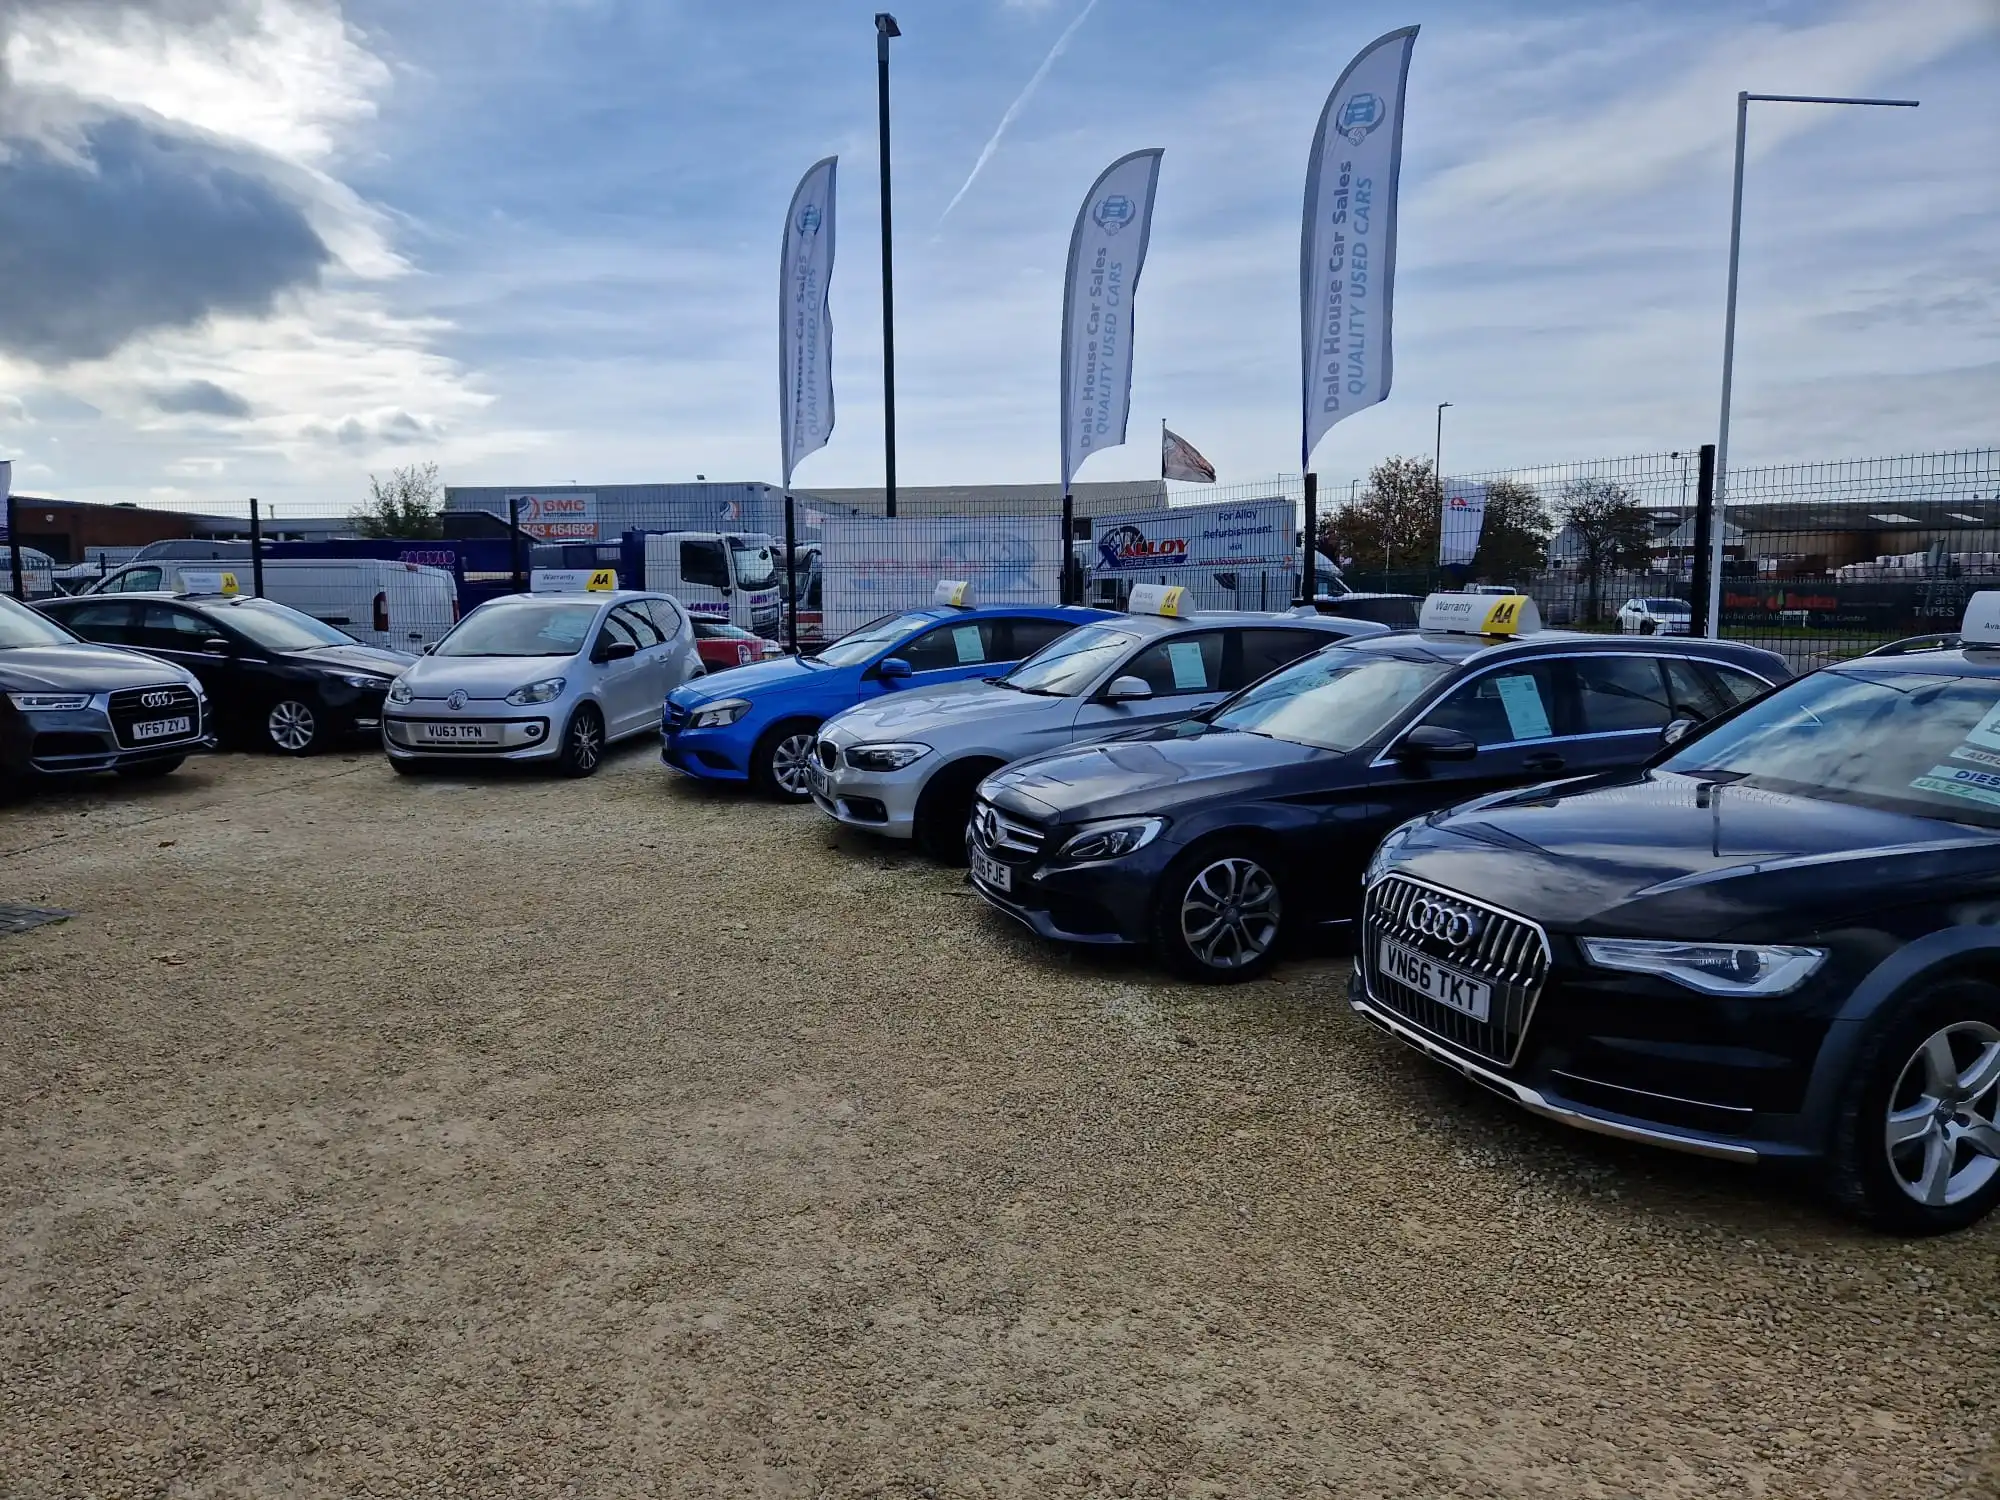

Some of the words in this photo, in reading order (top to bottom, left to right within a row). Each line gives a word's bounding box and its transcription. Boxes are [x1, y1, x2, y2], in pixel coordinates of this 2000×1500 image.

[1332, 160, 1352, 225] Sales
[1353, 177, 1373, 236] CARS
[1090, 247, 1107, 296] Sales
[1329, 231, 1346, 273] Car
[1350, 242, 1369, 299] USED
[1107, 261, 1122, 307] CARS
[1087, 302, 1100, 336] Car
[1102, 312, 1118, 357] USED
[1324, 280, 1343, 356] House
[1083, 341, 1098, 401] House
[1347, 305, 1366, 395] QUALITY
[807, 364, 820, 436] QUALITY
[1096, 364, 1114, 435] QUALITY
[1324, 362, 1340, 413] Dale
[1080, 408, 1093, 449] Dale
[543, 499, 586, 512] GMC
[1218, 512, 1234, 521] For
[1235, 509, 1258, 520] Alloy
[549, 523, 594, 536] 464692
[1119, 539, 1190, 557] ALLOY
[1203, 525, 1273, 540] Refurbishment
[543, 573, 576, 581] Warranty
[592, 574, 609, 585] AA
[1435, 600, 1473, 614] Warranty
[1490, 602, 1516, 624] AA
[138, 722, 166, 737] YF67
[167, 718, 187, 732] ZYJ
[428, 725, 457, 737] VU63
[458, 726, 482, 737] TFN
[1387, 943, 1432, 991] VN66
[1437, 968, 1480, 1011] TKT
